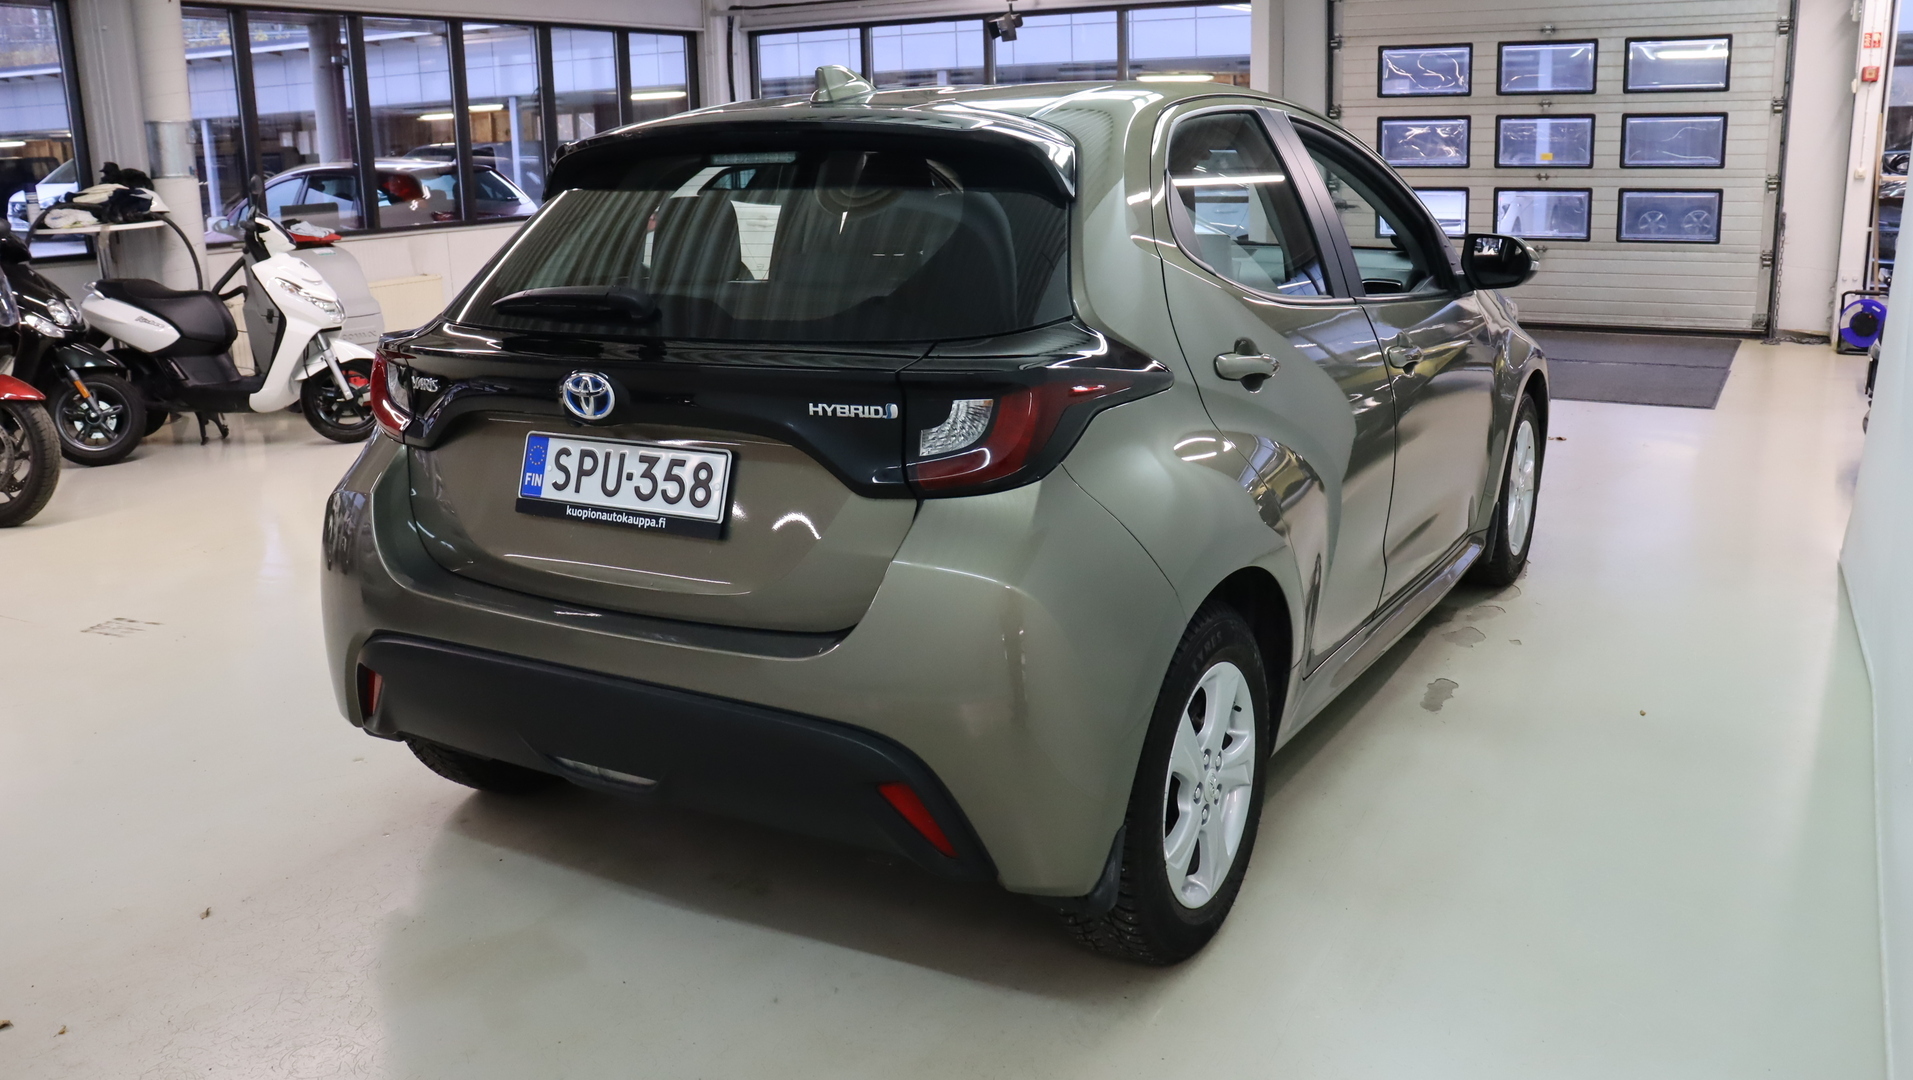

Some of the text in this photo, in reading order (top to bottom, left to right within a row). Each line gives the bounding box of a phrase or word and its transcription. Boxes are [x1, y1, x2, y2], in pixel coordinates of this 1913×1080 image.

[808, 402, 883, 418] HYBRID
[524, 472, 543, 487] FIN
[551, 447, 714, 509] SPU-358
[566, 505, 666, 528] kuopionautokauppa.fi
